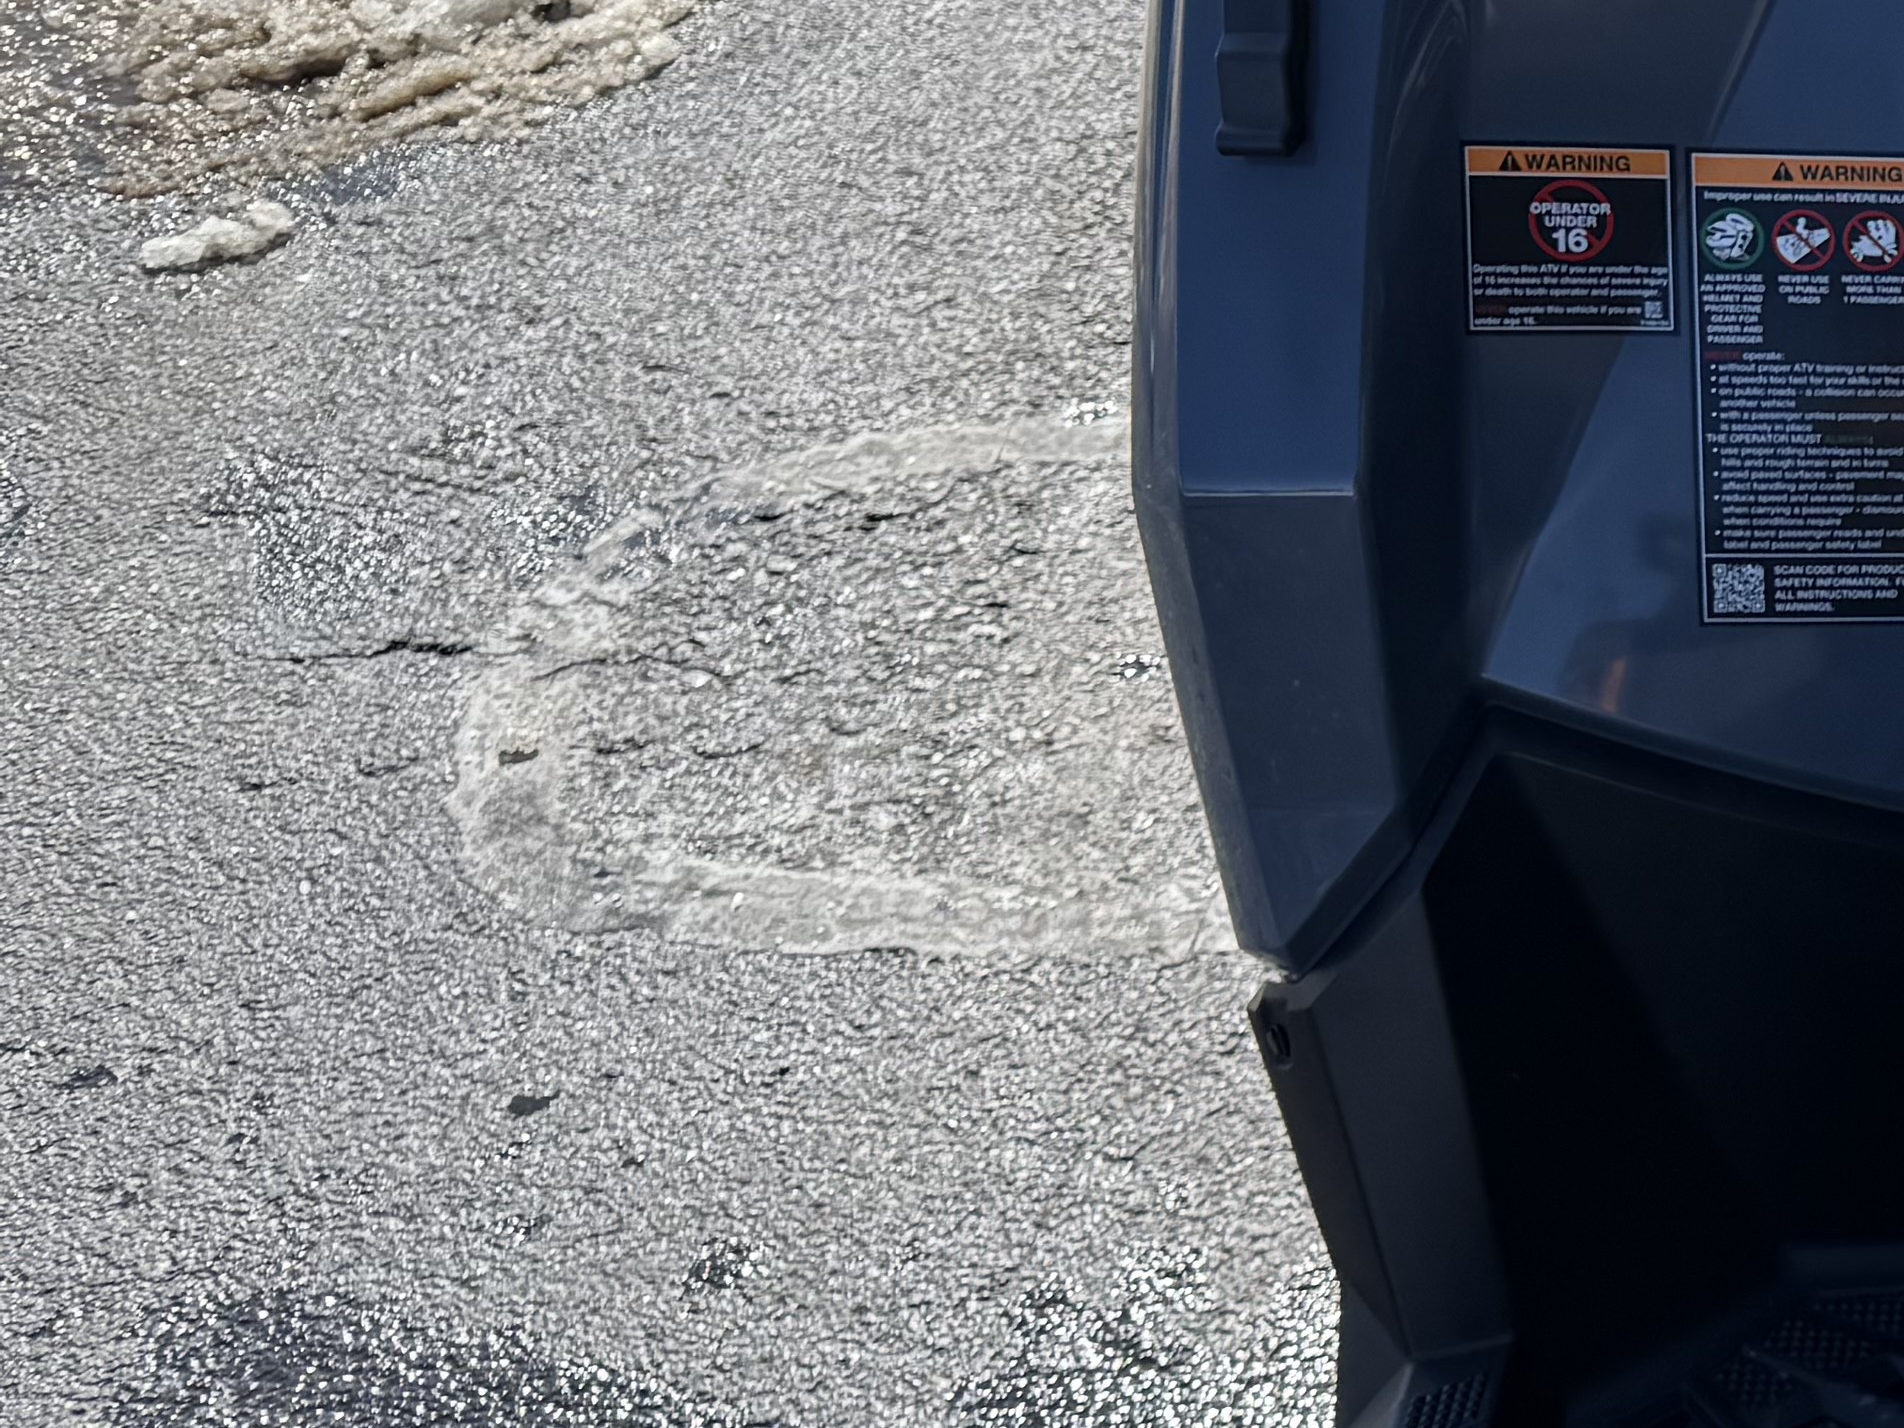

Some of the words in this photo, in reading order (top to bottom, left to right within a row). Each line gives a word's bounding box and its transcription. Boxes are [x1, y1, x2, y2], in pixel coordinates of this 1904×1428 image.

[1525, 154, 1630, 172] WARNING
[1800, 165, 1902, 182] WARNING
[1530, 202, 1611, 215] OPERATOR
[1545, 216, 1597, 227] UNDER
[1553, 228, 1588, 252] 16
